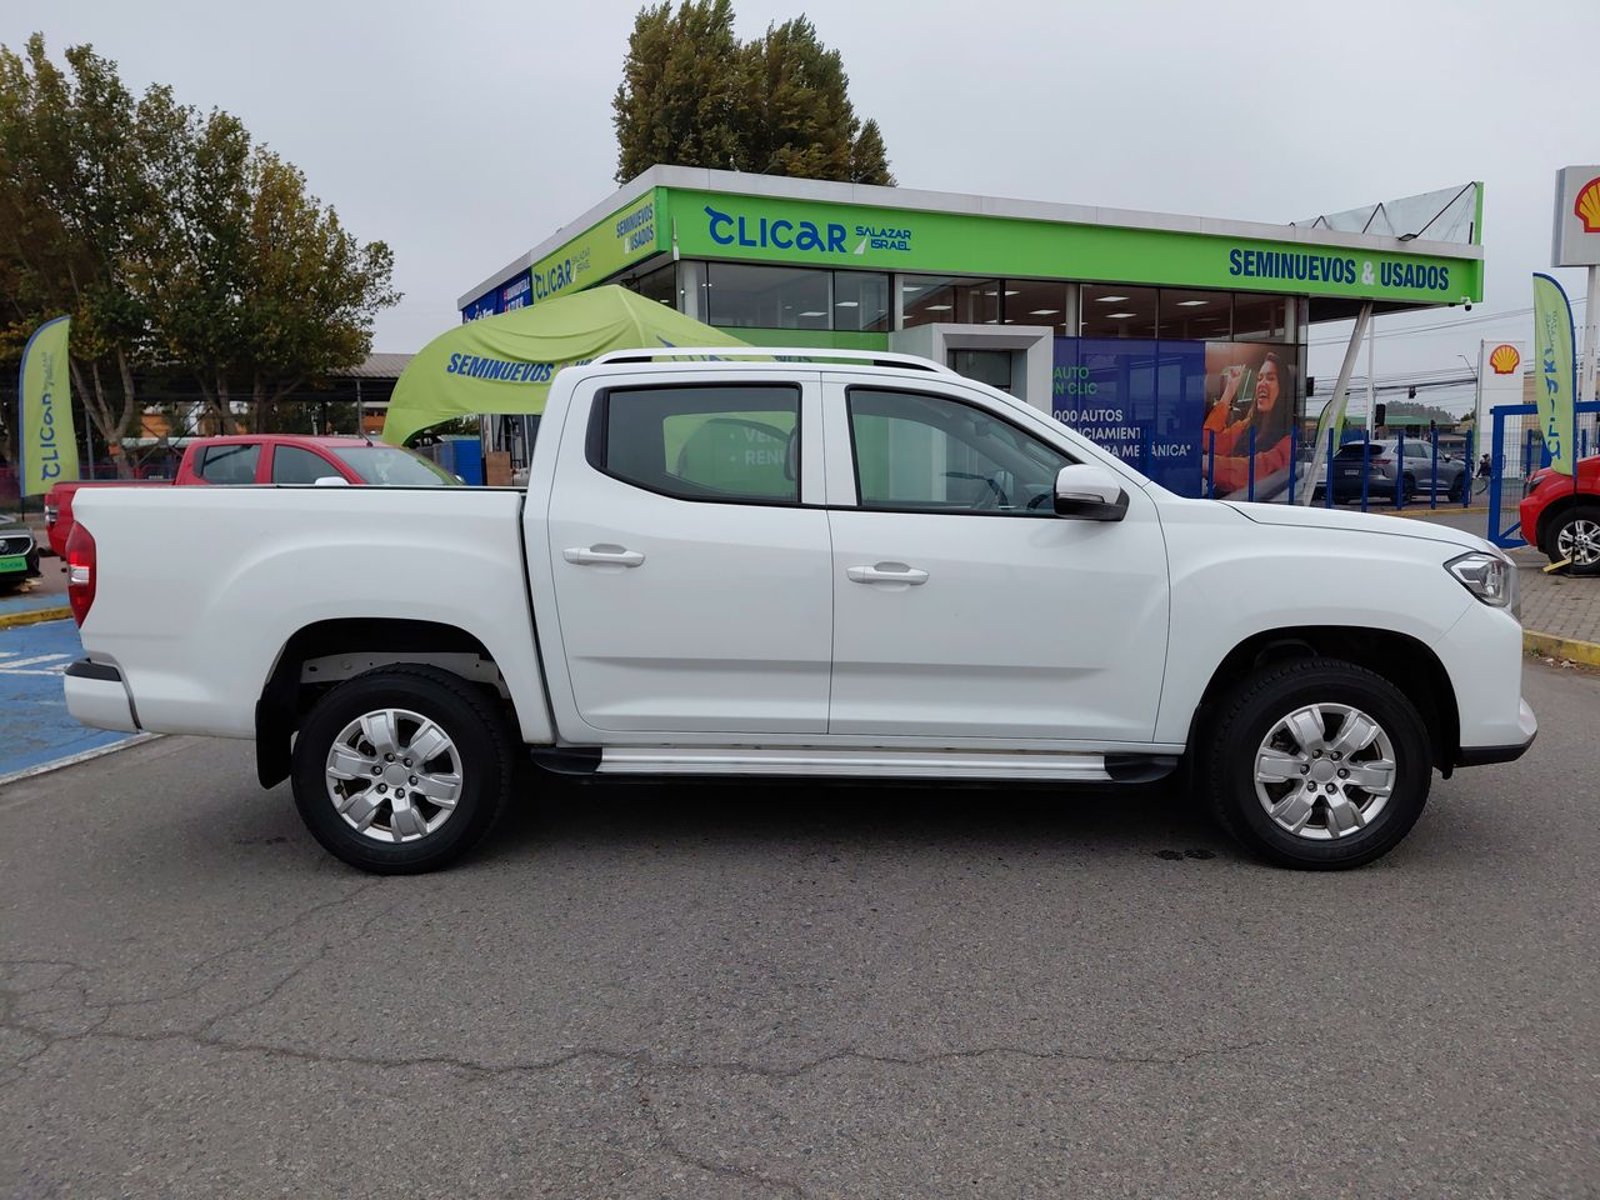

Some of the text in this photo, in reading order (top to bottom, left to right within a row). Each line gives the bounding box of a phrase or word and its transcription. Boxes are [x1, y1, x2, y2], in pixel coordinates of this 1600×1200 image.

[855, 226, 912, 239] SALAZAR
[870, 238, 911, 251] ISRAEL
[1229, 248, 1449, 291] SEMINUEVOS & USADOS
[446, 353, 554, 382] SEMINUEVOS
[1054, 366, 1089, 379] AUTO
[1054, 382, 1098, 395] N CLIC
[1081, 409, 1123, 422] AUTOS
[1122, 444, 1191, 457] MEÁNICA
